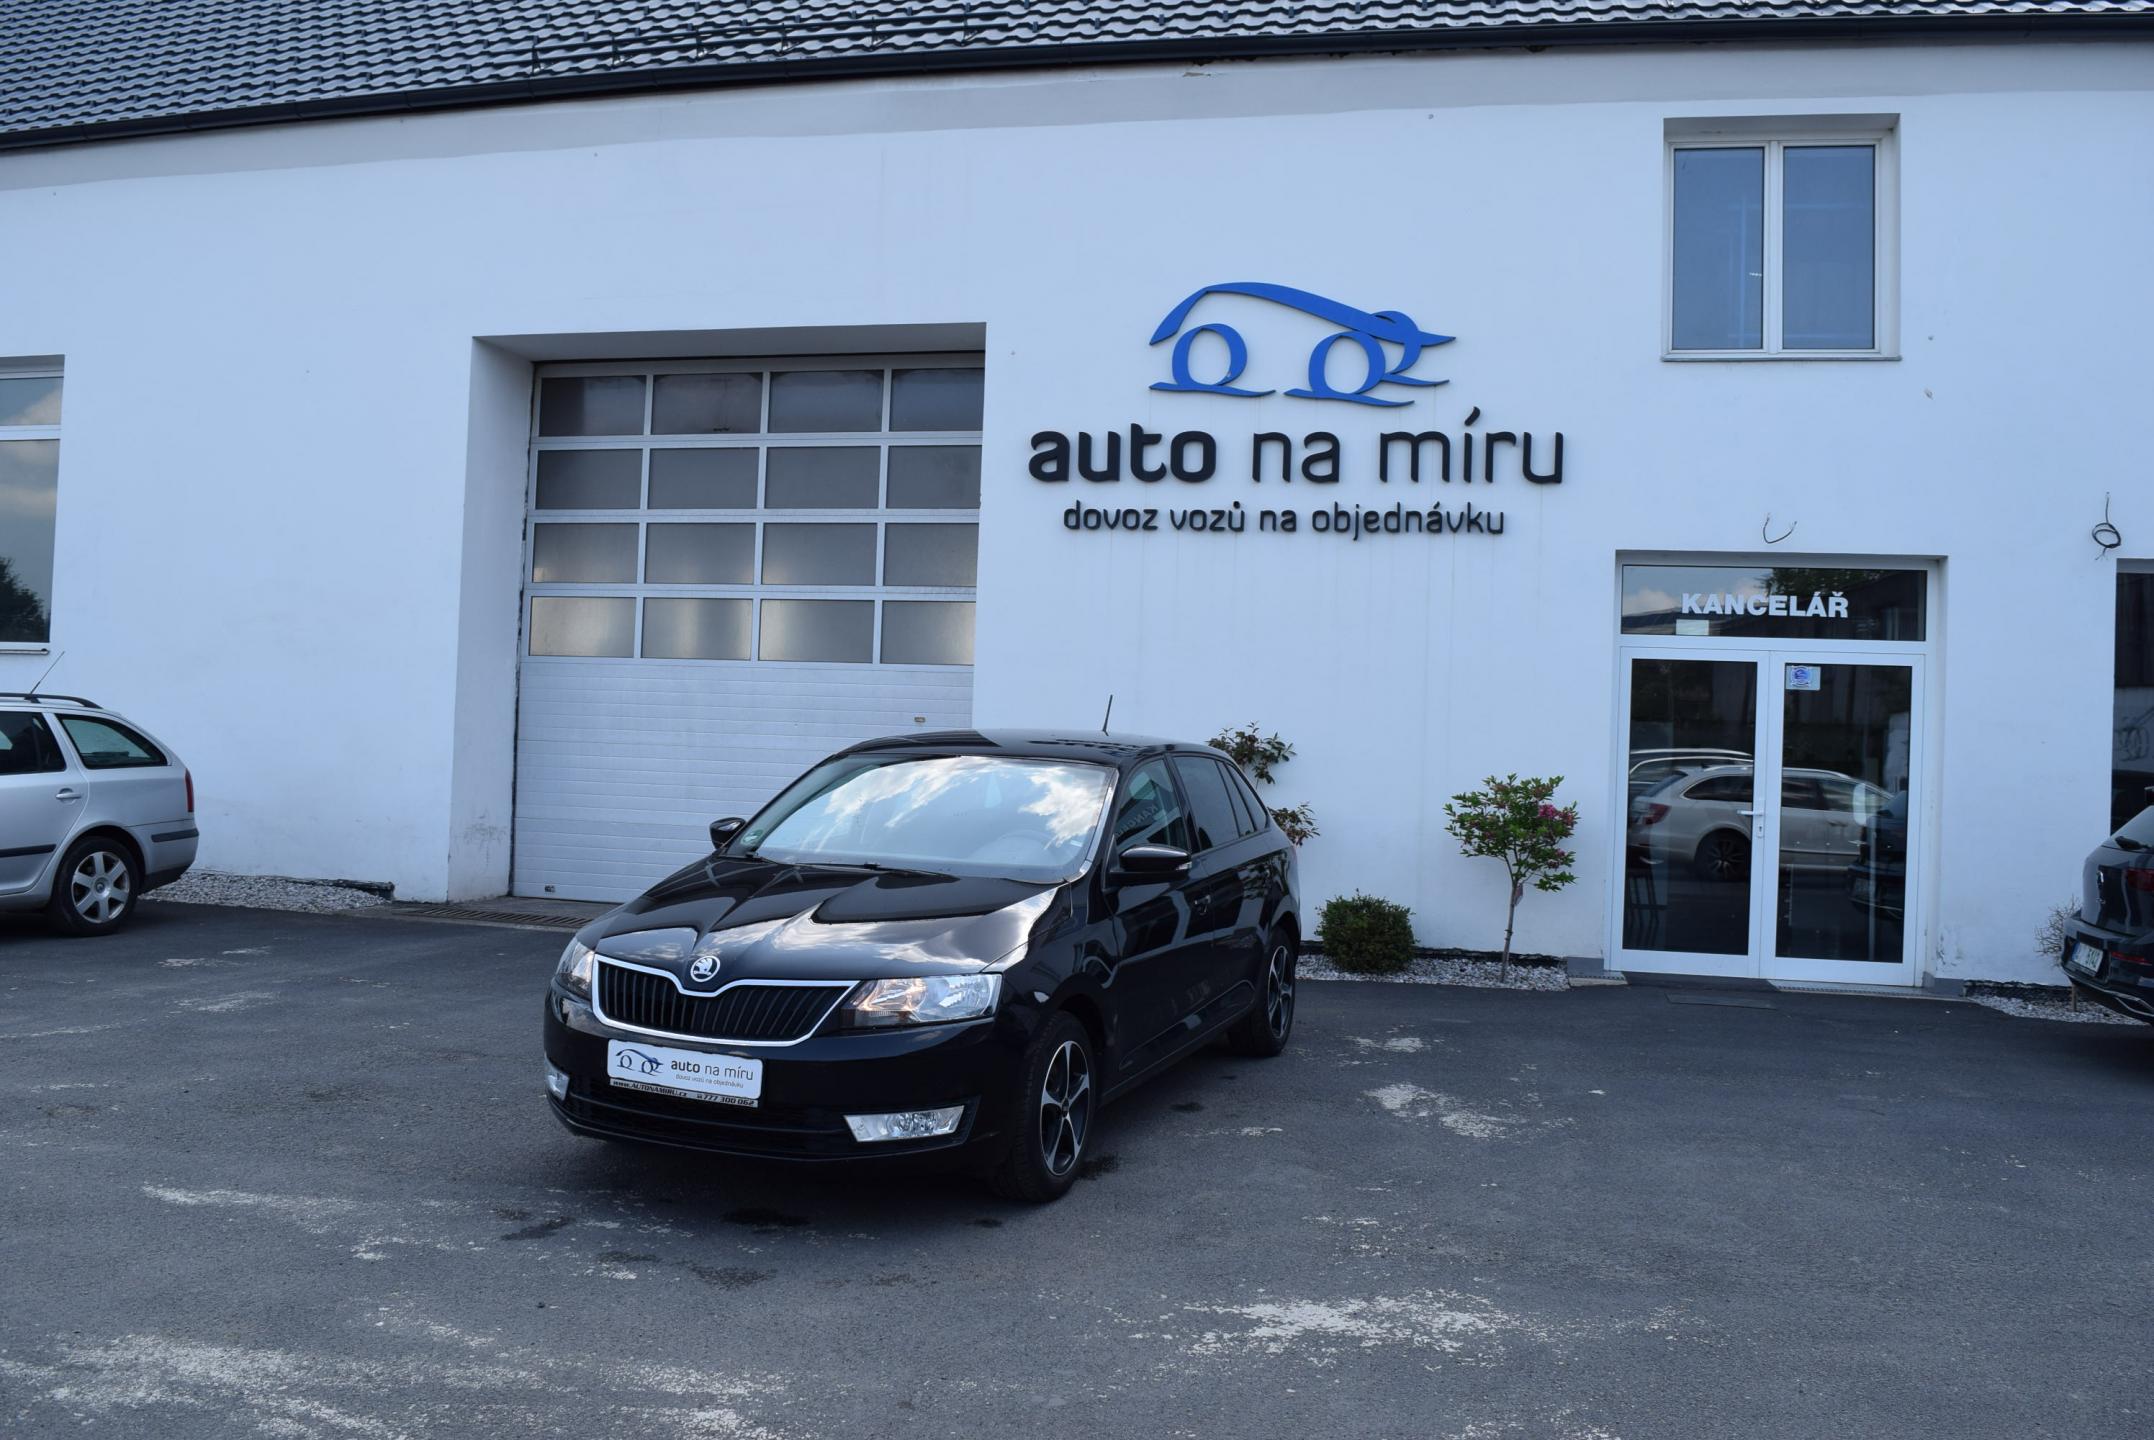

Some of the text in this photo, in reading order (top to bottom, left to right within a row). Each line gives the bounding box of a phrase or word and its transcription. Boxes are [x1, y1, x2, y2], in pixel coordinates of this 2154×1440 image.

[1028, 406, 1563, 484] auto na míru
[1063, 500, 1504, 541] dovoz vozů na objednávku
[1681, 591, 1849, 618] KANCELÁŘ
[671, 1060, 754, 1081] auto na míru
